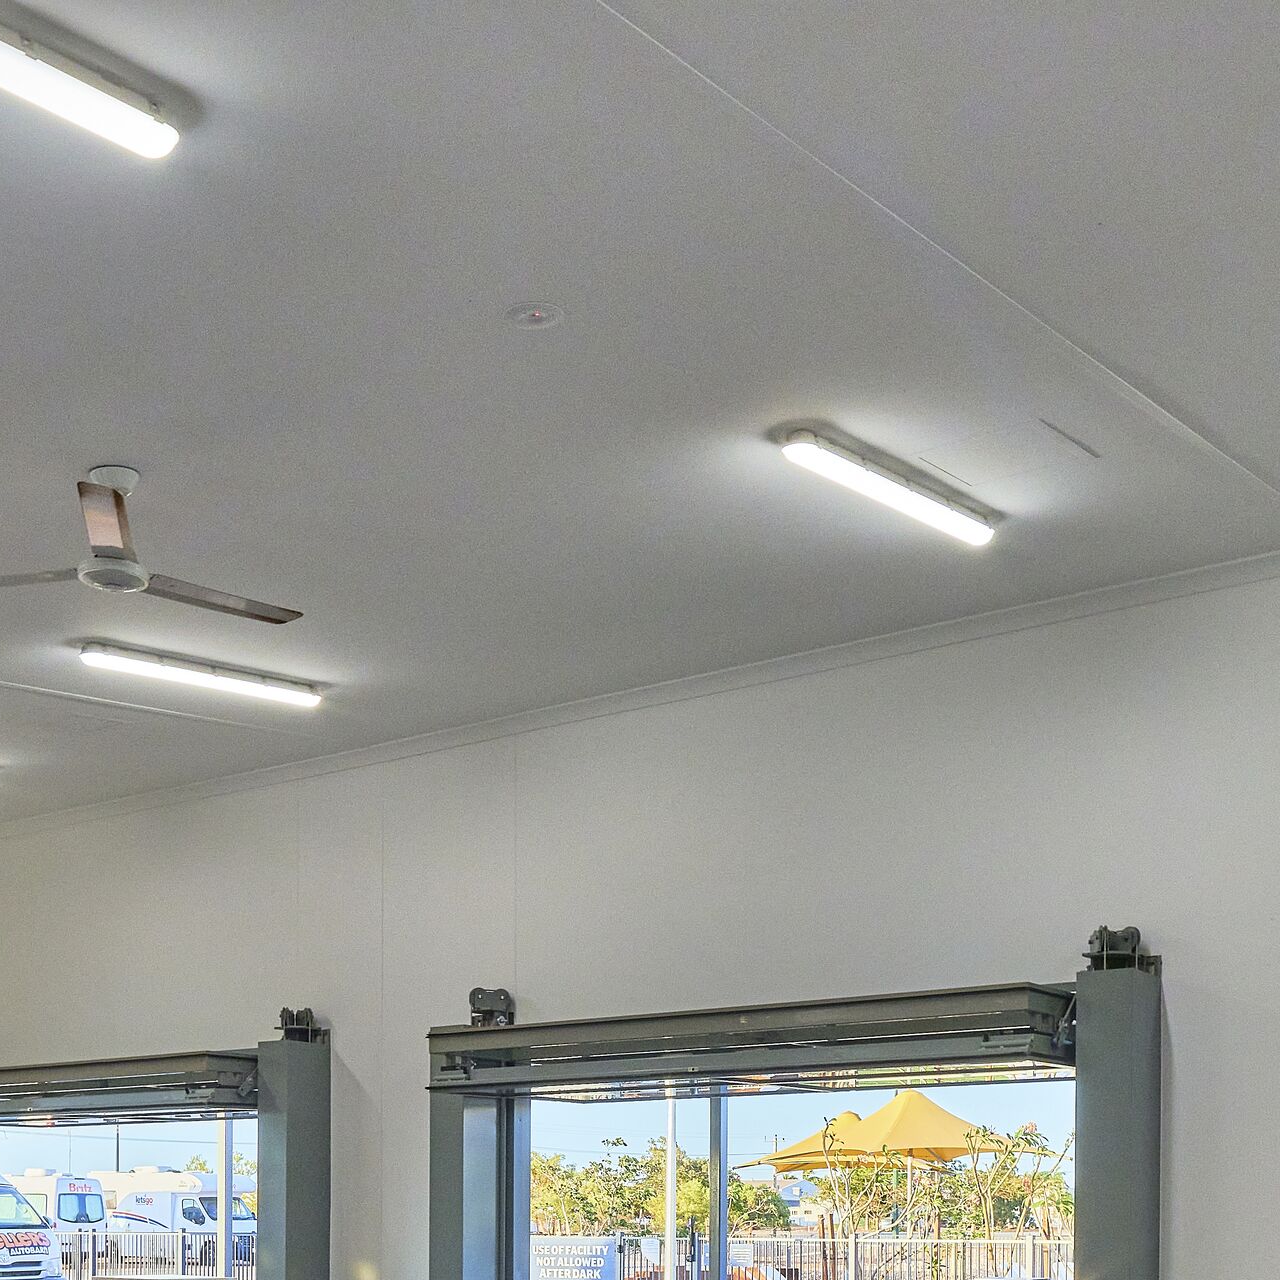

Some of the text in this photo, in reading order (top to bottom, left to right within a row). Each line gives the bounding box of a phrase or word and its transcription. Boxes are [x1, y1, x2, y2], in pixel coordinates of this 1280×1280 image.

[69, 1182, 93, 1192] Britz
[532, 1245, 609, 1255] USE OF FACILITY
[536, 1257, 605, 1267] NOT ALLOWED
[539, 1268, 602, 1279] AFTER DARK
